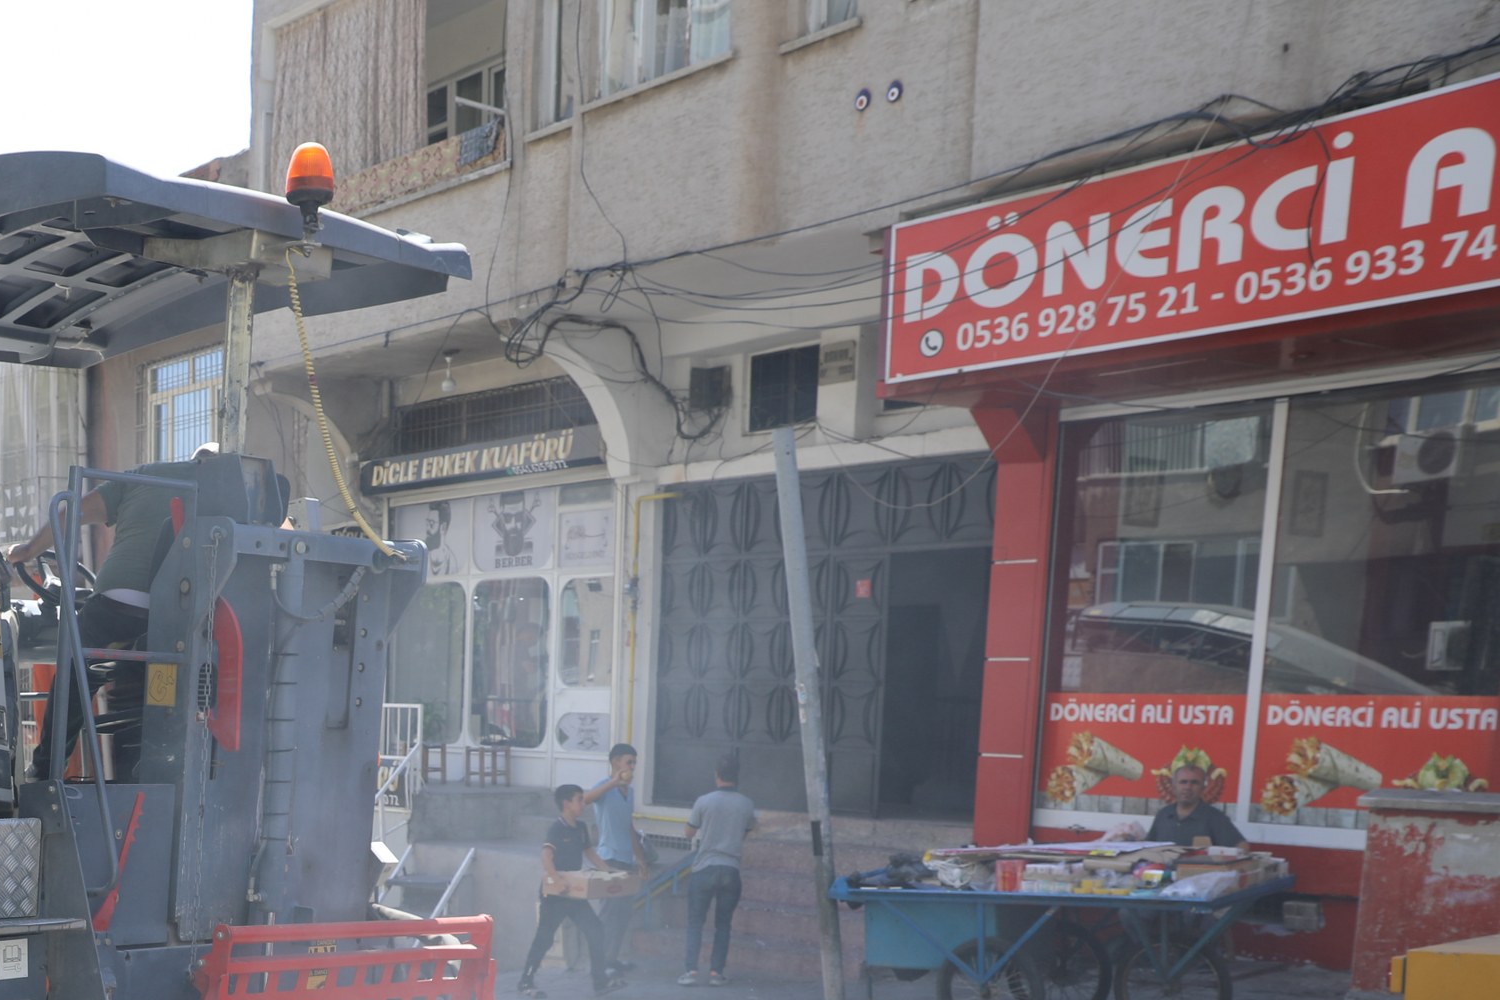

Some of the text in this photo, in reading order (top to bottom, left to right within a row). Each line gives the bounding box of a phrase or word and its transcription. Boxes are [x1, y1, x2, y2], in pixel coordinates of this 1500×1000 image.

[903, 131, 1355, 323] DÖNERCİ
[956, 313, 1030, 352] 0536
[1038, 301, 1096, 338] 928
[1106, 292, 1147, 328] 75
[1157, 283, 1199, 320] 21
[1234, 253, 1333, 305] 0536
[1344, 239, 1425, 287] 933
[1441, 225, 1496, 268] 74
[372, 428, 573, 487] DİCLE ERKEK KUAFÖRÜ
[495, 555, 533, 569] BERBER
[1050, 698, 1234, 726] DÖNERCİ ALİ USTA
[1267, 701, 1498, 731] DÖNERCİ ALİ USTA
